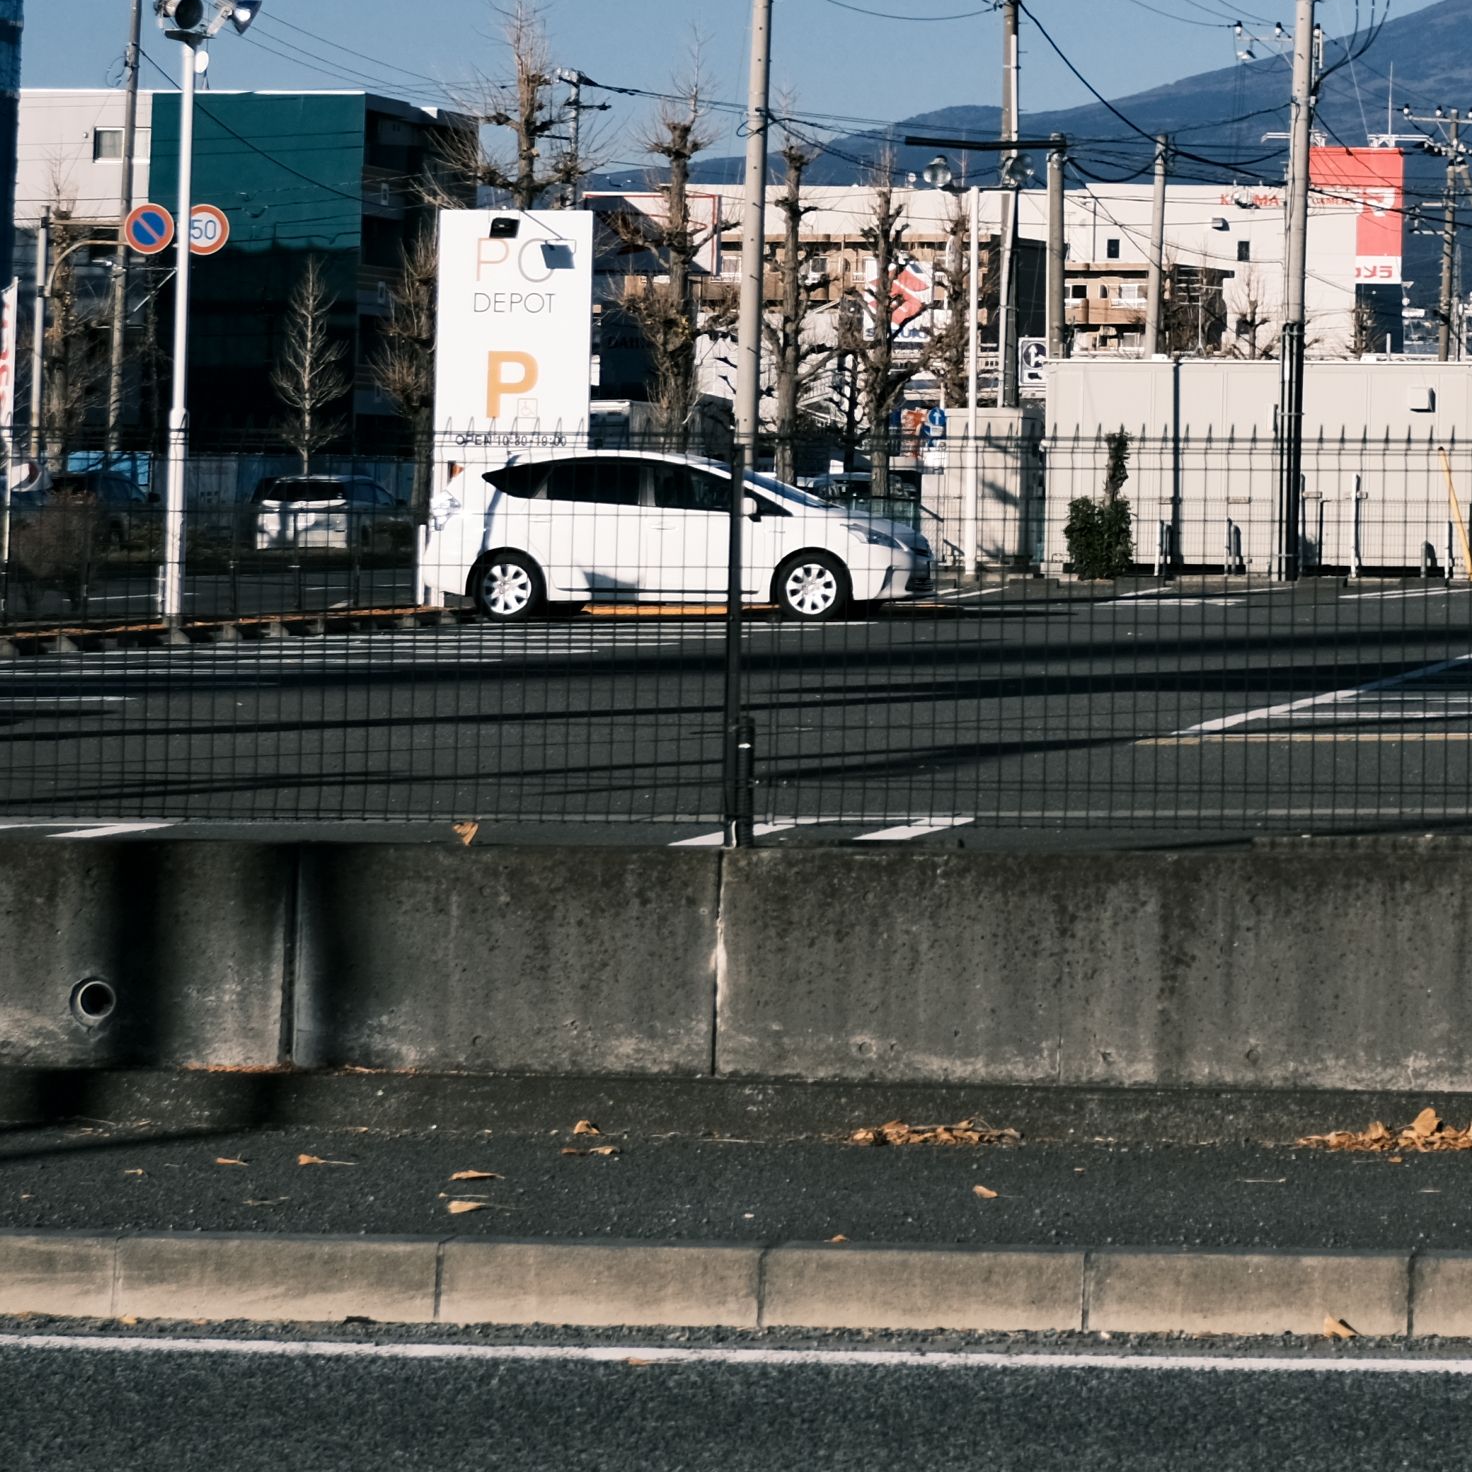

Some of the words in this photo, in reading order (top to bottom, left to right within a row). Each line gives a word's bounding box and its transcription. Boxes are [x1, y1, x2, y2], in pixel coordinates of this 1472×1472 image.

[190, 219, 217, 240] 50
[473, 292, 557, 314] DEPOT
[486, 350, 539, 419] P
[455, 434, 493, 446] OPEN
